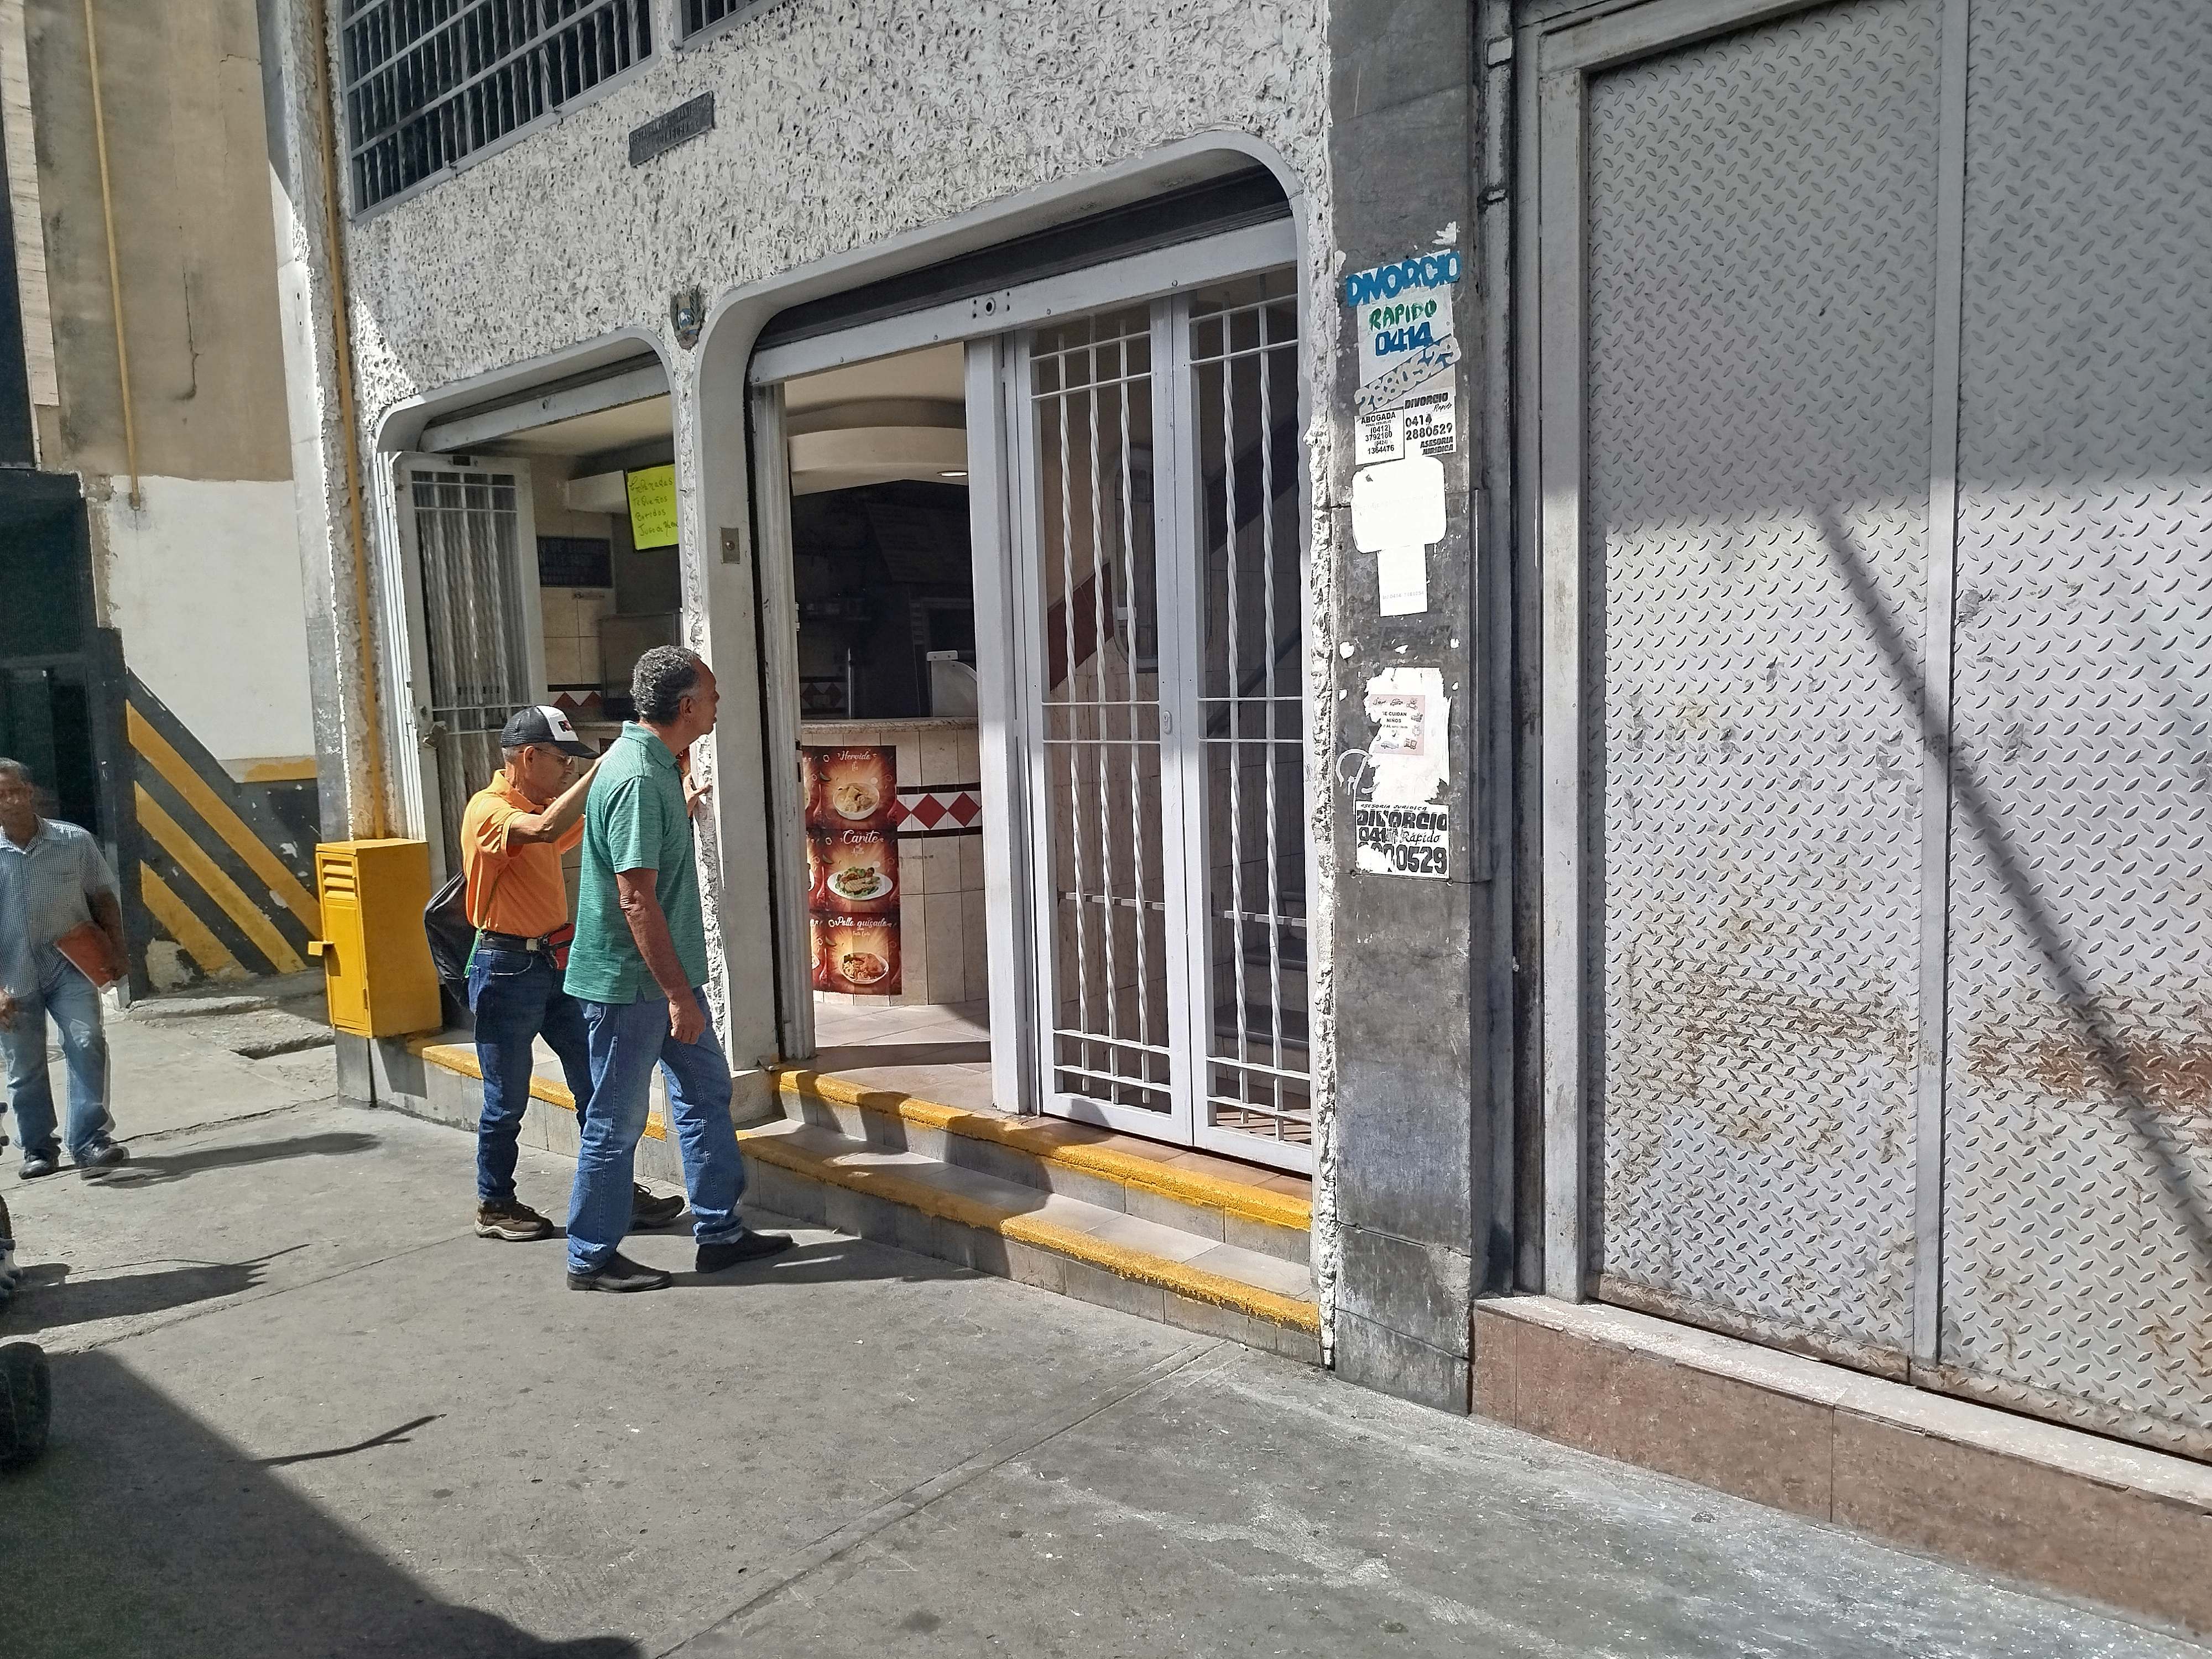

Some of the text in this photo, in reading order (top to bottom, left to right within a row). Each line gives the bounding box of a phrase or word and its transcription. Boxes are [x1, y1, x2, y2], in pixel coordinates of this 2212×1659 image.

[1346, 251, 1462, 307] DIVORCIO
[1369, 299, 1437, 331] RAPIDO
[1375, 321, 1434, 357] 0414
[1404, 392, 1448, 409] DIVORCIO
[1361, 411, 1396, 424] ABOGADA
[1365, 431, 1392, 441] 3792180
[1370, 424, 1390, 434] (0412)
[1420, 436, 1453, 448] ASESORIA
[1368, 445, 1395, 455] 1364476
[840, 750, 871, 761] Hervido
[1357, 810, 1447, 831] DIVORCIO
[842, 830, 880, 844] Carite
[836, 916, 888, 931] Pollo guisado
